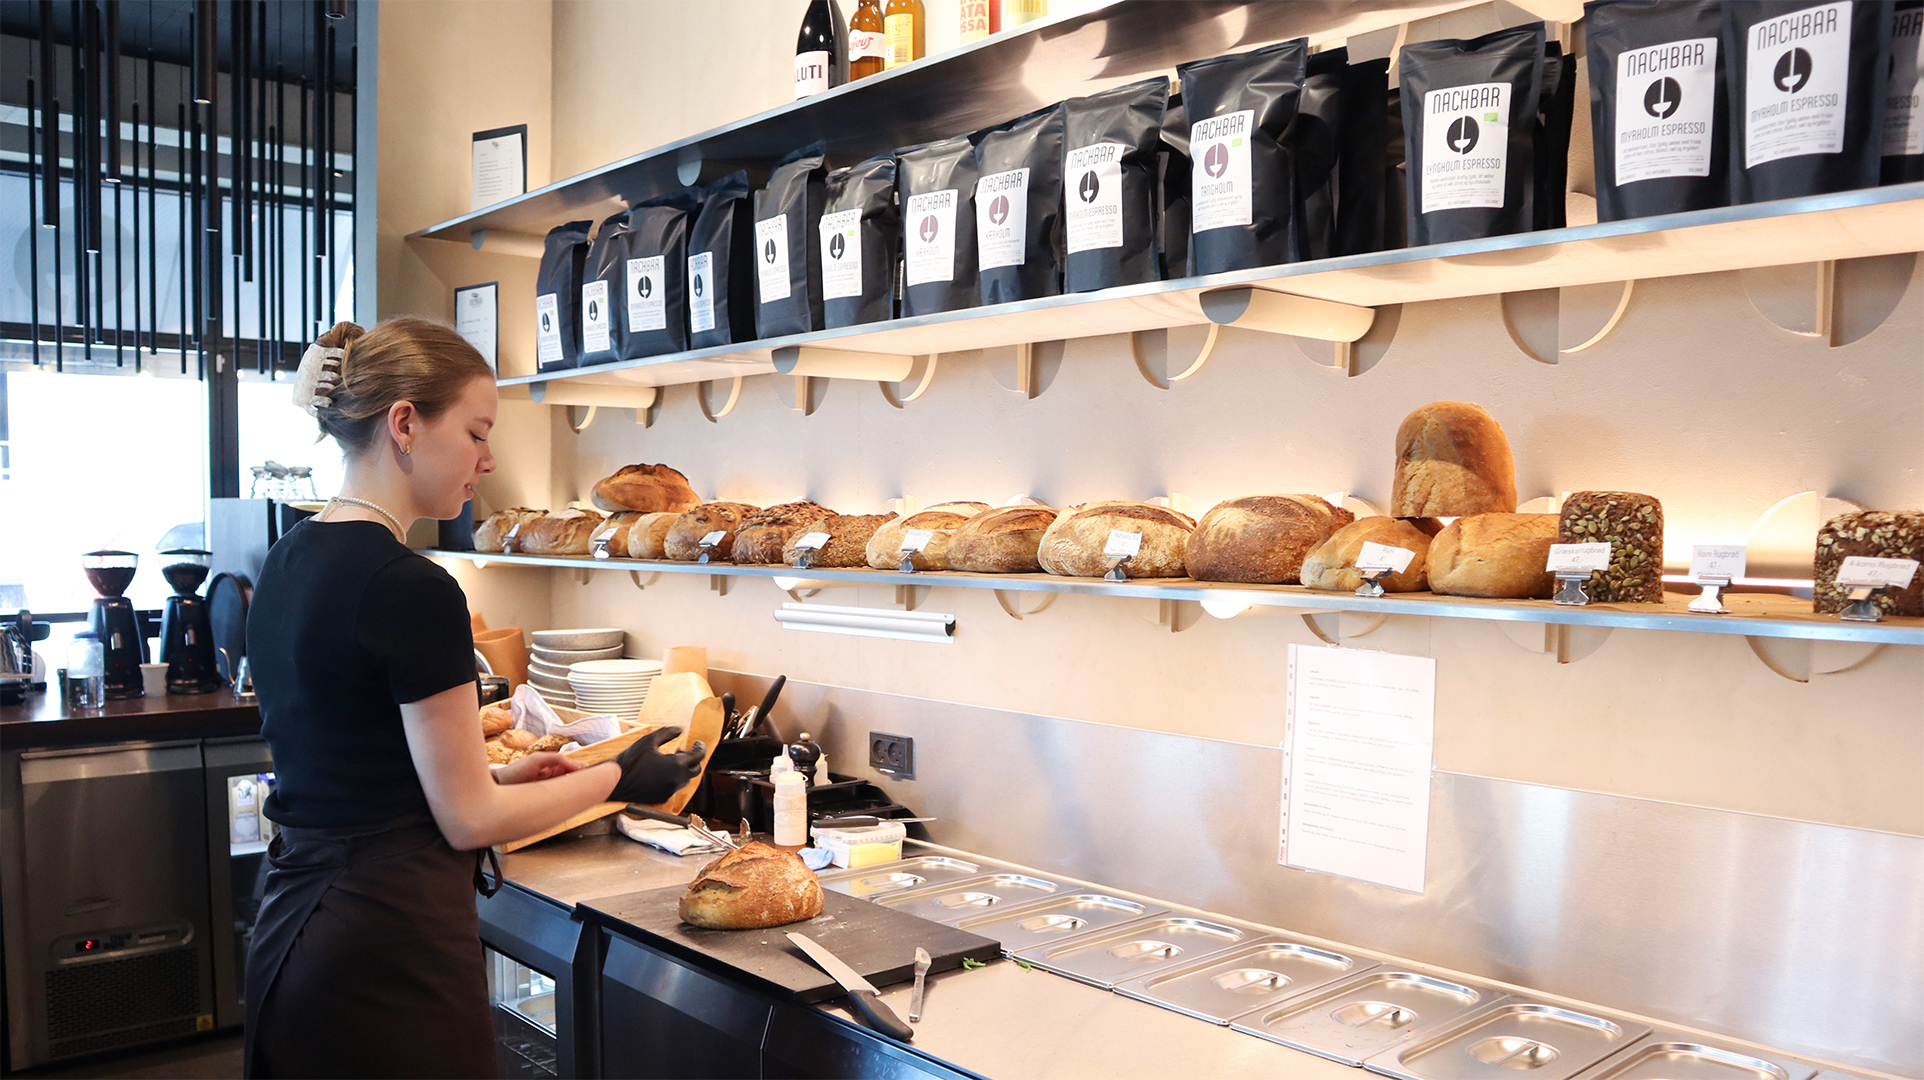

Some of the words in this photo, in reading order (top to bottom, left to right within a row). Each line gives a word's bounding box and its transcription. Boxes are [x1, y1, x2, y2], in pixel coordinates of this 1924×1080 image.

[960, 18, 987, 33] SSA
[1757, 8, 1838, 51] NACHBAR
[1627, 43, 1704, 77] NACHBAR
[795, 64, 822, 83] LUTI
[1433, 87, 1500, 114] NACHBAR
[1751, 100, 1788, 123] MYRHOLM
[1791, 93, 1838, 112] ESPRESSO
[1195, 114, 1245, 143] NACHBAR
[1620, 125, 1659, 144] MYRHOLM
[1662, 122, 1706, 136] ESPRESSO
[1071, 145, 1115, 170] NACHBAR
[1426, 159, 1461, 175] LYNGHOLM
[1463, 158, 1500, 170] ESPRESSO
[981, 171, 1023, 194] NACHBAR
[911, 193, 951, 213] NACHBAR
[1089, 204, 1118, 217] ESPRESSO
[85, 940, 93, 949] 2
